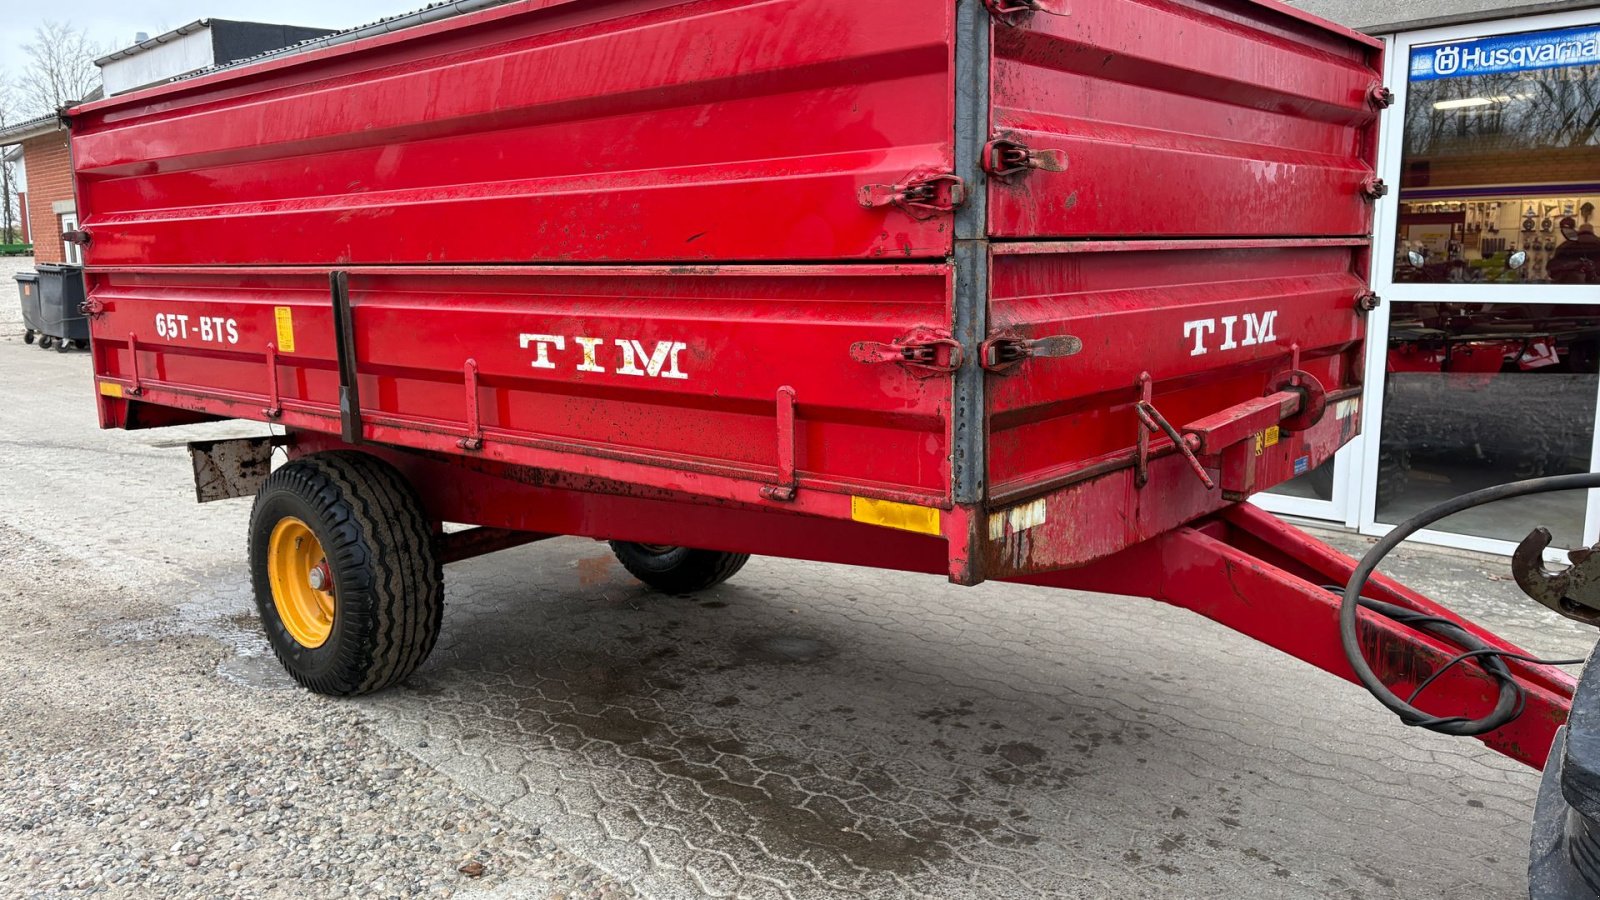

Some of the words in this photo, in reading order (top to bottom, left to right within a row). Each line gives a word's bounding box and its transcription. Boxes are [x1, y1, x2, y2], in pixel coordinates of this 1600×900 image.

[1462, 39, 1596, 69] Husqvarna
[519, 333, 689, 380] TIM
[1183, 310, 1278, 357] TIM
